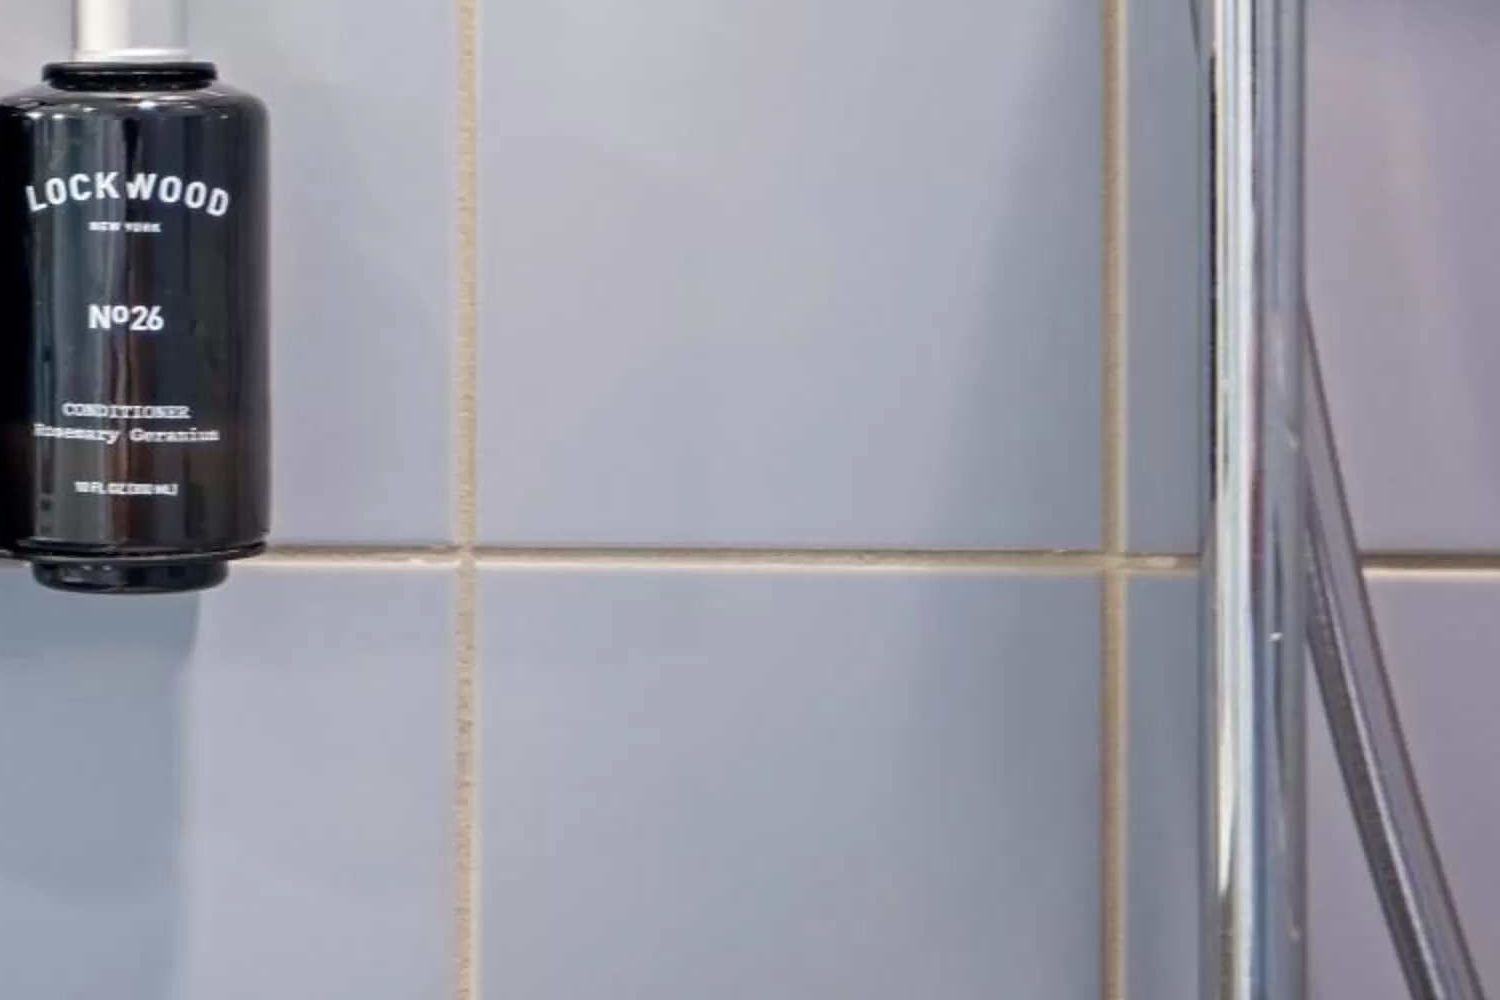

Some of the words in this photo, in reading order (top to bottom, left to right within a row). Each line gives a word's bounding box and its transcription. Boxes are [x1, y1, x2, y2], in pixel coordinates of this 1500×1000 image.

[25, 171, 229, 217] LOCKWOOD
[88, 221, 121, 231] NEW
[123, 222, 162, 233] YORK
[61, 402, 192, 419] CONDITIONER
[33, 422, 121, 444] Rosemary
[129, 427, 221, 442] Geranium
